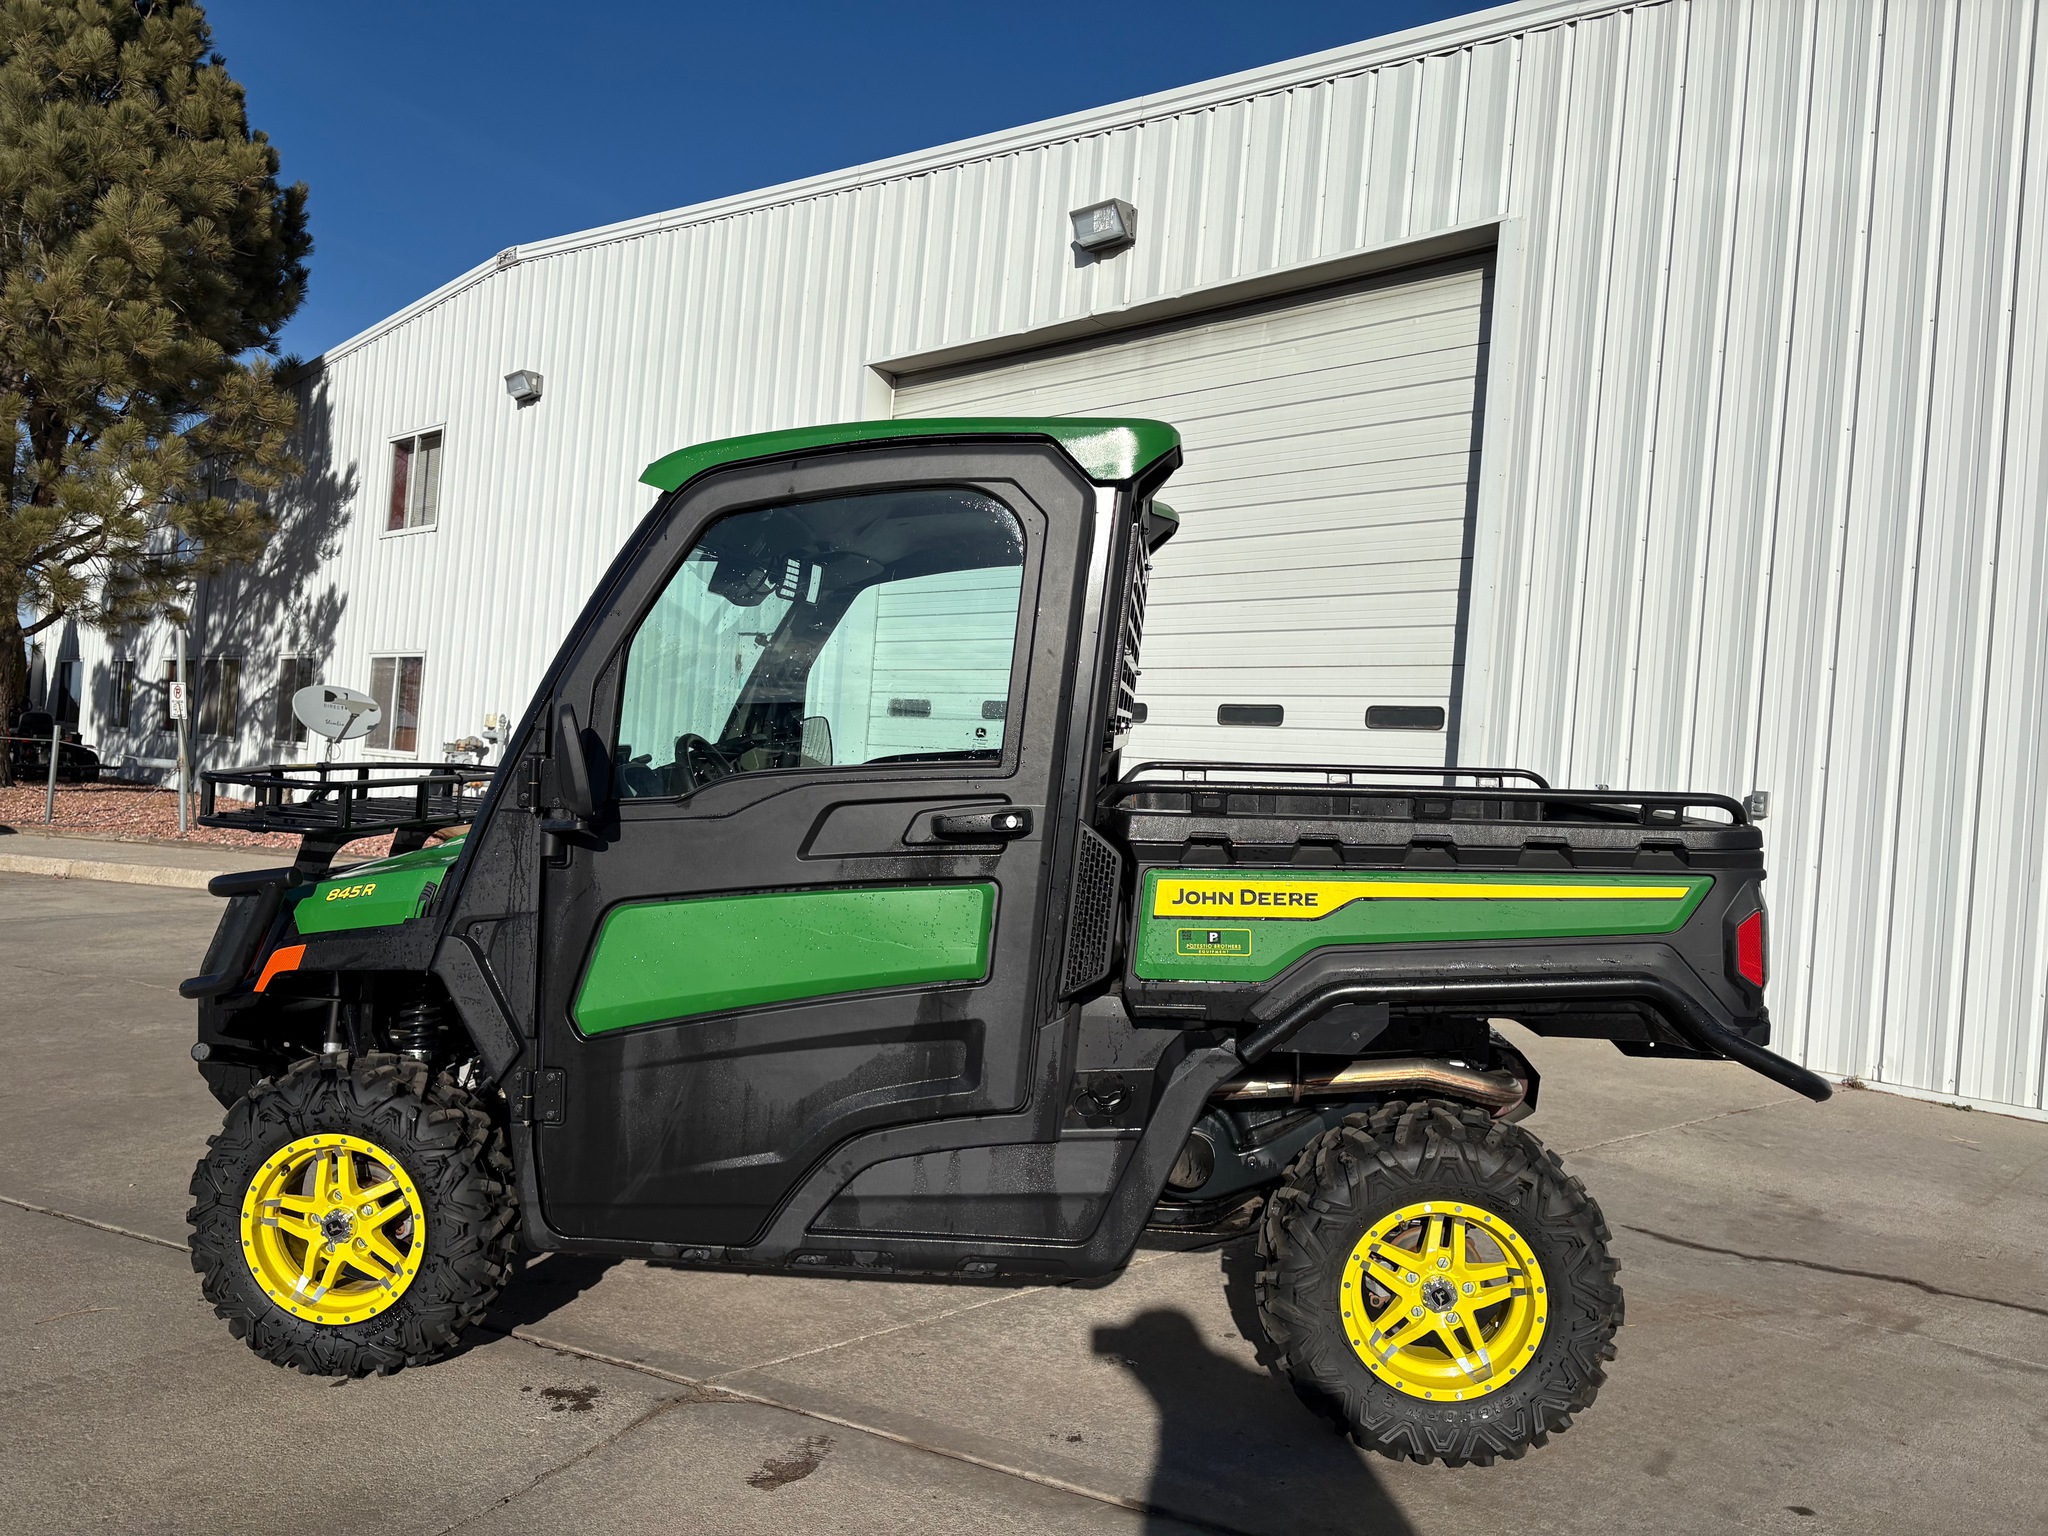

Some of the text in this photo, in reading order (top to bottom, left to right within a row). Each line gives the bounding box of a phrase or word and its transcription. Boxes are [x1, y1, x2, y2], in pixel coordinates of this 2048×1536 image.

[325, 883, 377, 902] 845R
[1172, 888, 1319, 907] JOHN DEERE
